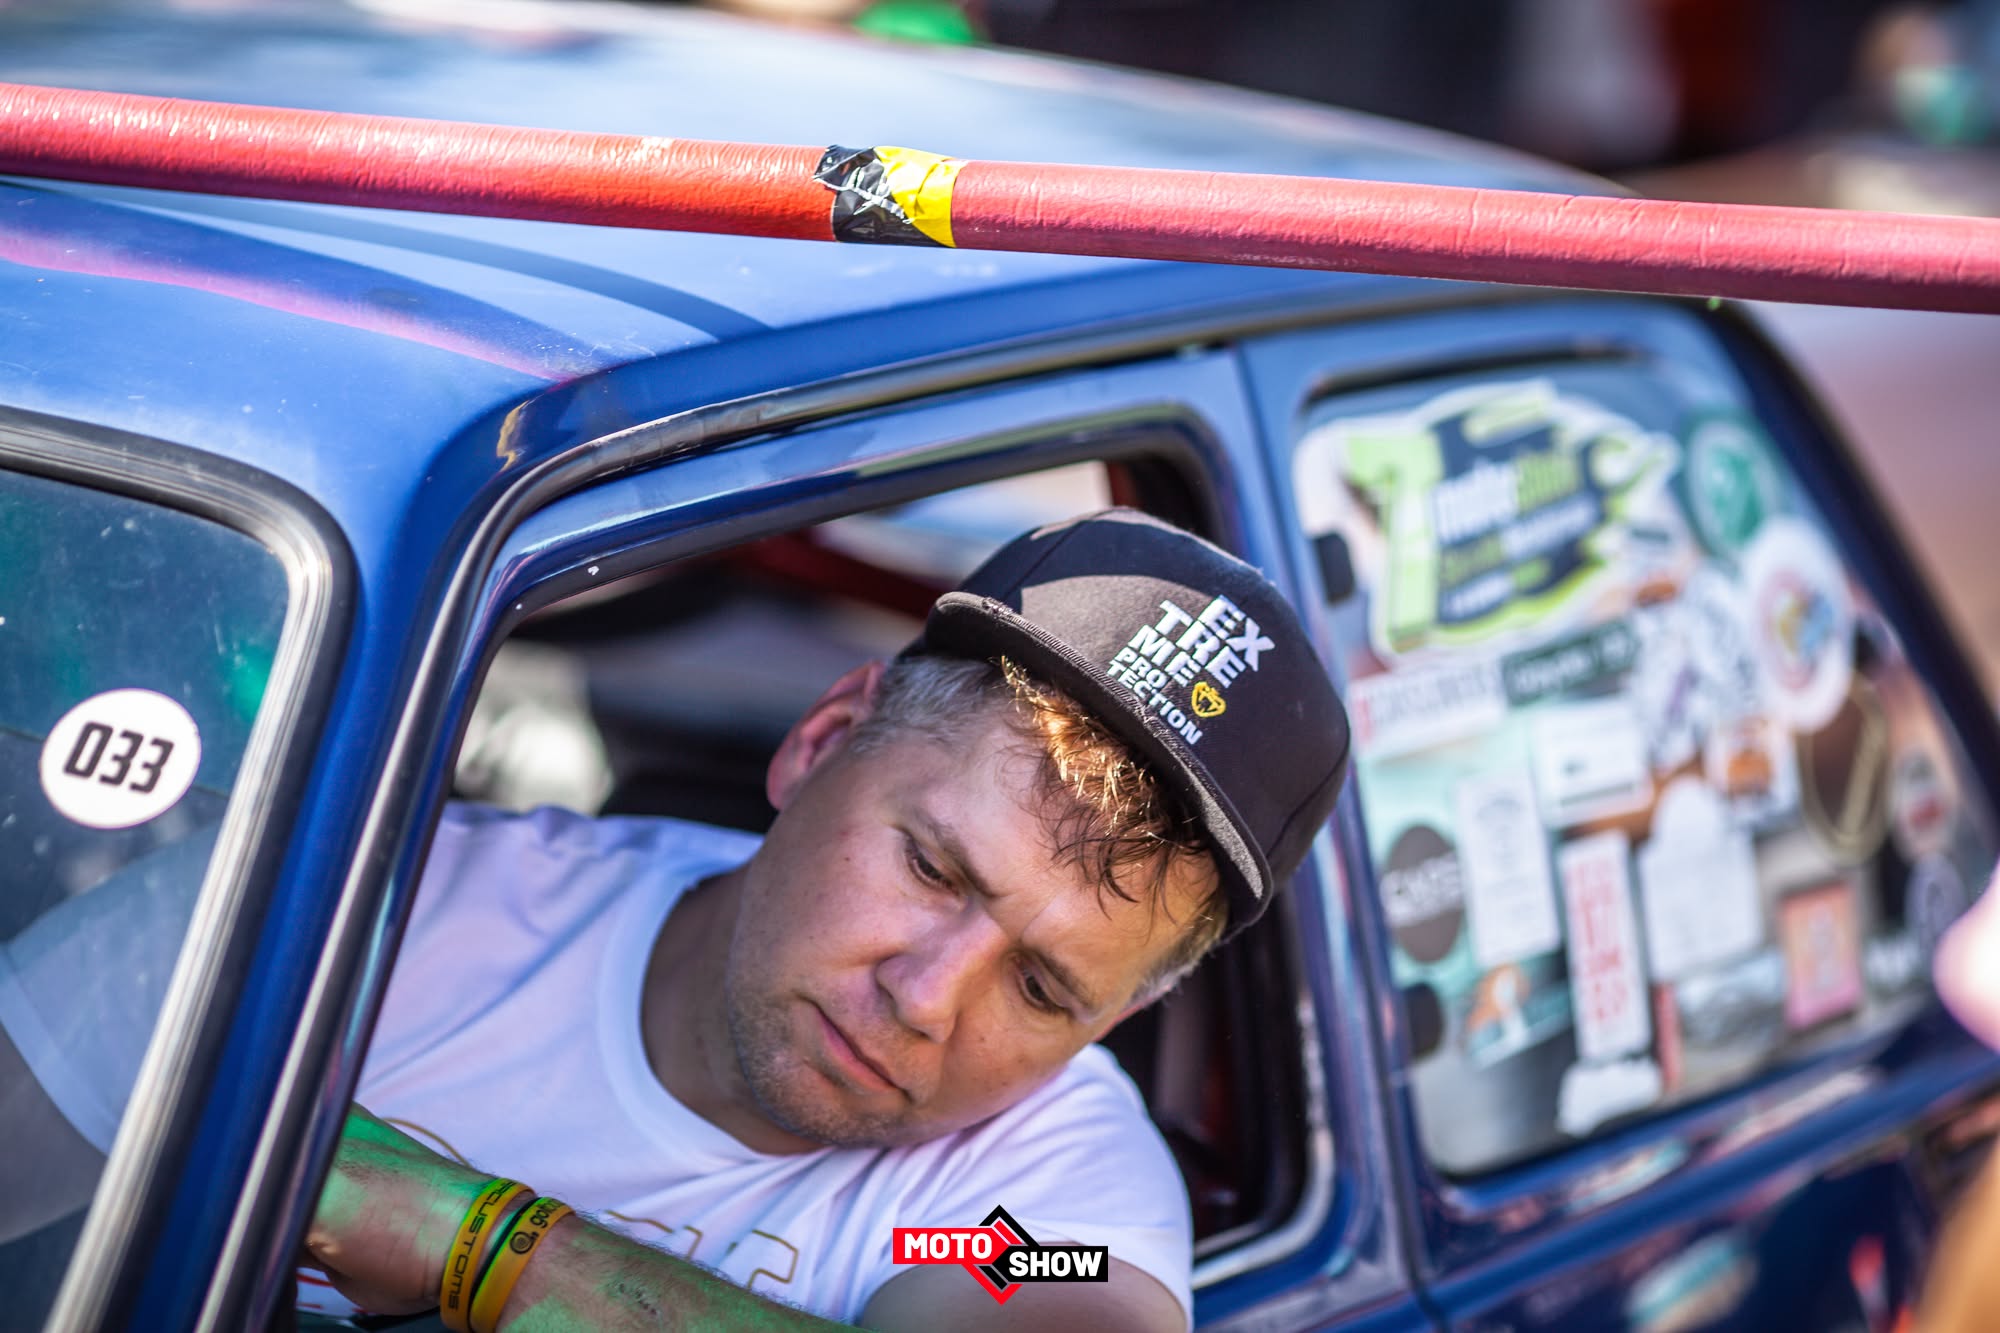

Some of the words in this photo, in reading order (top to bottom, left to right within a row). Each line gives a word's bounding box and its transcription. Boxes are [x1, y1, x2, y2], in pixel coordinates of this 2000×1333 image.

[1115, 647, 1169, 689] PRO
[1127, 624, 1201, 688] ME
[1155, 600, 1246, 689] TRE
[1198, 594, 1275, 672] EX
[1106, 660, 1203, 745] TECTION
[63, 721, 175, 794] 033
